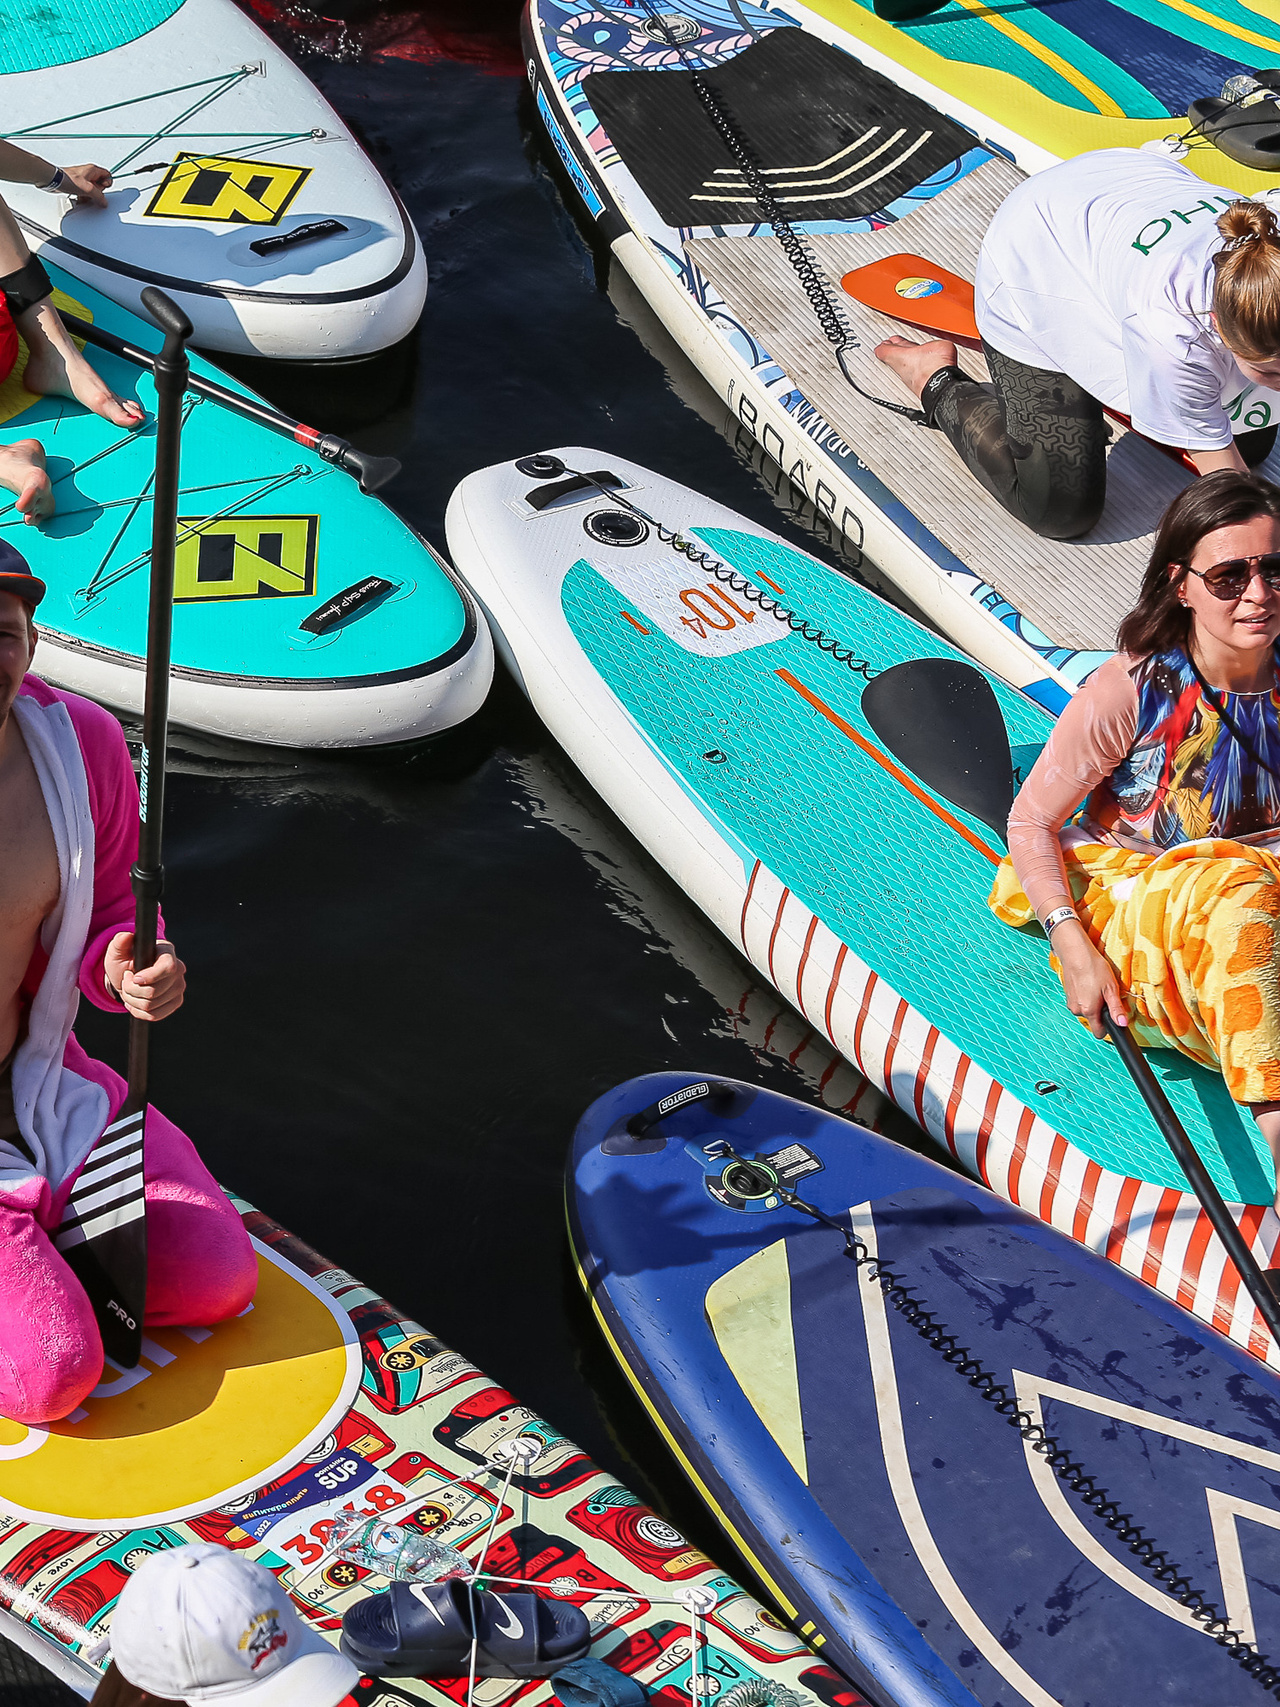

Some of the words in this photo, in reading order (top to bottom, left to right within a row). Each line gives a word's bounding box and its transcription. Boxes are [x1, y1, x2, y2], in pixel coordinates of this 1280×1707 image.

[107, 1300, 137, 1331] PRO
[318, 1459, 359, 1490] SUP
[253, 1519, 272, 1538] 2022
